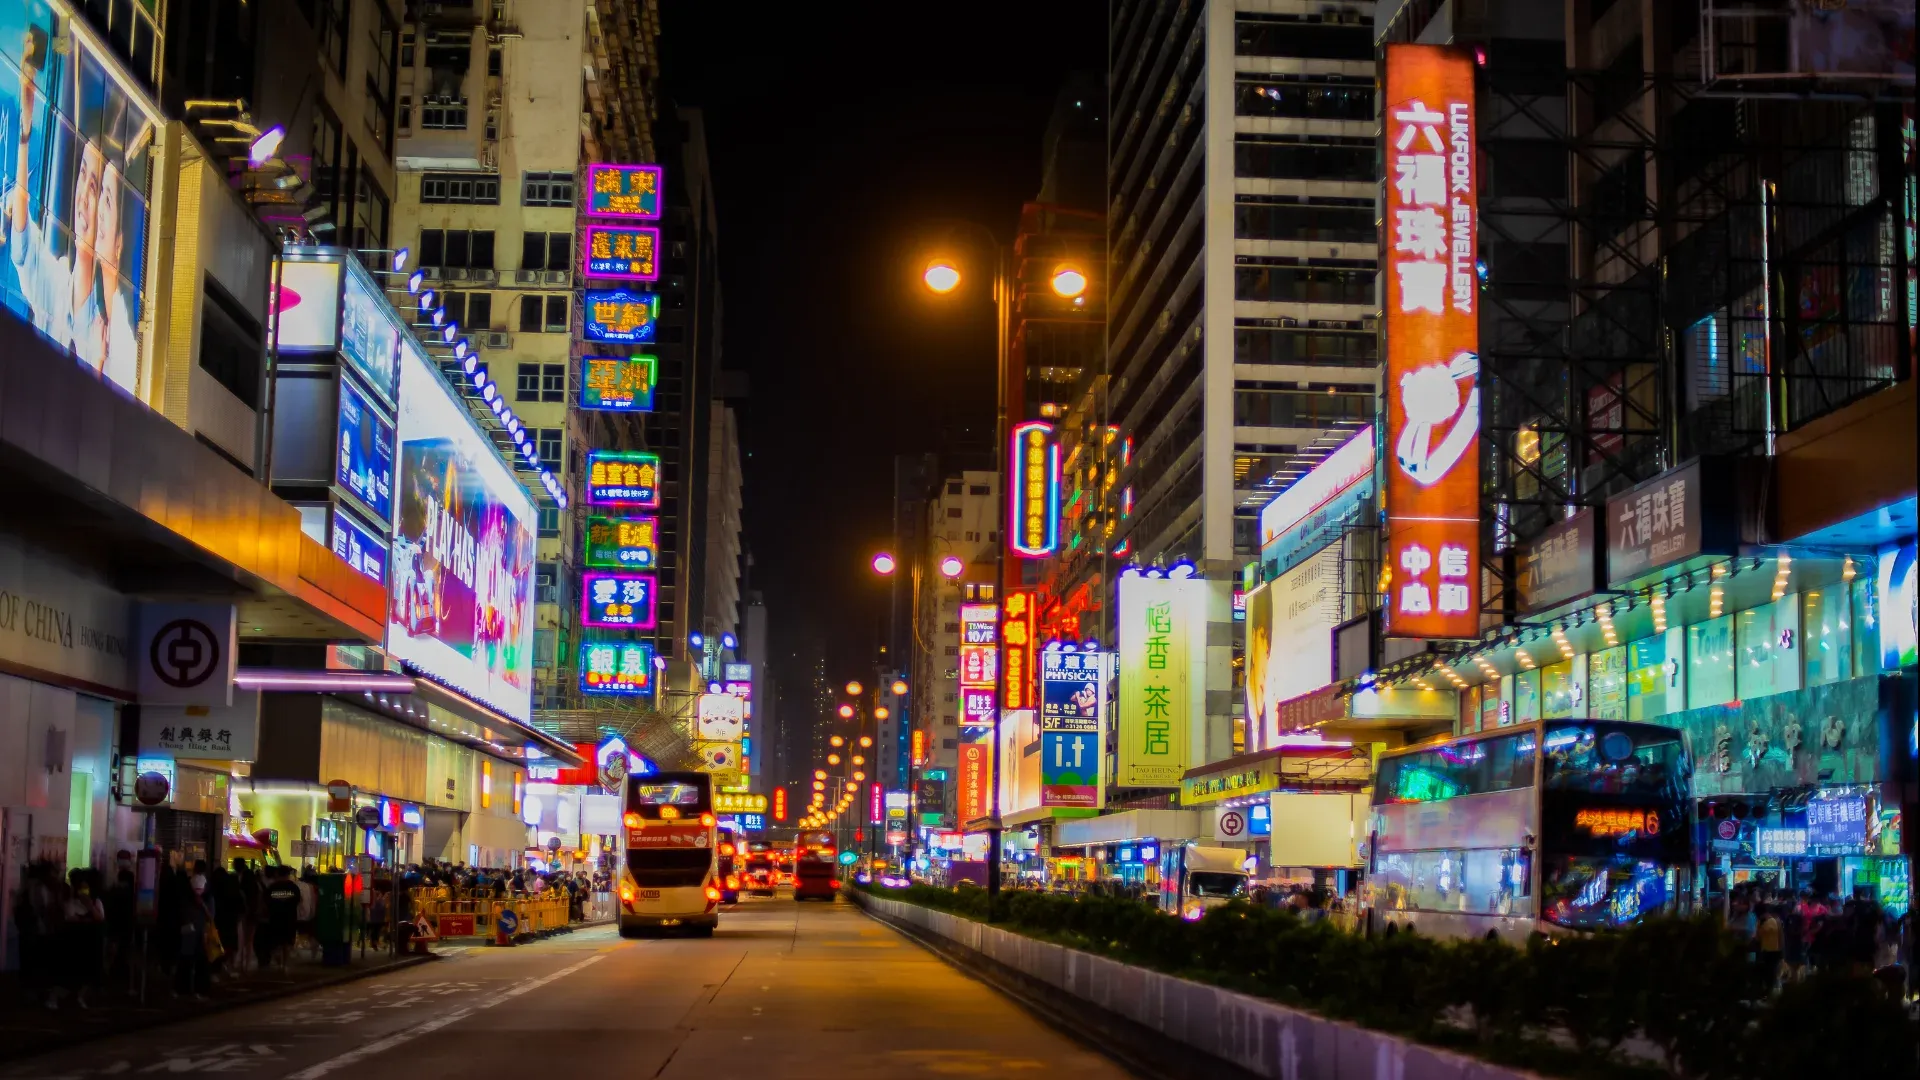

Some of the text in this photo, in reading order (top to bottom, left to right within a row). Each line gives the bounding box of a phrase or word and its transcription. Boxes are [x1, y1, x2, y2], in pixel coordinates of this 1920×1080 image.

[1396, 102, 1447, 315] 六福珠寶
[1450, 103, 1471, 313] LUKFOOK JEWELLERY
[594, 302, 648, 326] 世紀
[588, 360, 648, 391] 亞洲
[1619, 480, 1686, 546] 六福珠寶
[426, 494, 455, 569] PLAY
[453, 522, 475, 589] HAS
[0, 591, 20, 631] OF
[24, 601, 73, 649] CHINA
[968, 631, 994, 643] 10/F
[1046, 672, 1099, 680] PHYSICAL
[159, 726, 232, 744] 創興銀行
[1044, 717, 1060, 729] 5/F
[158, 742, 184, 750] Chong
[1055, 735, 1085, 768] i.t
[1646, 810, 1659, 834] 6
[640, 890, 660, 898] KMB
